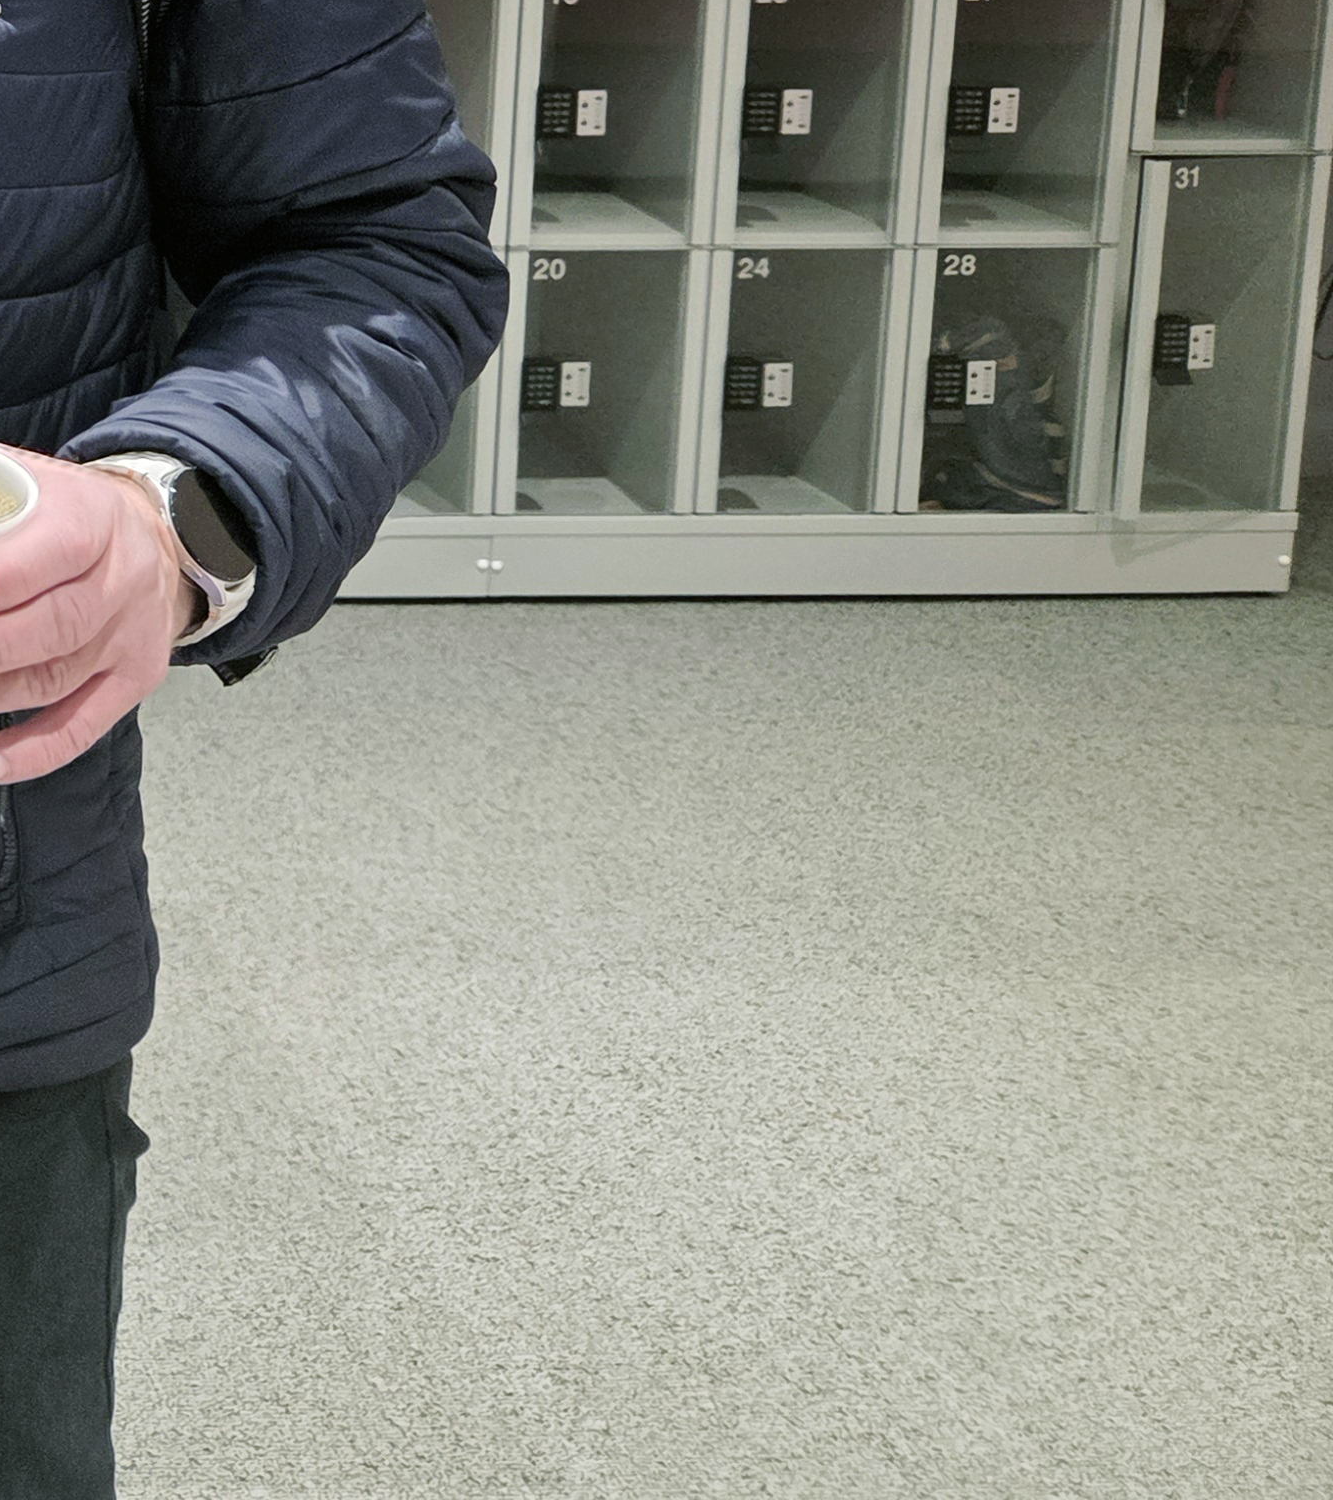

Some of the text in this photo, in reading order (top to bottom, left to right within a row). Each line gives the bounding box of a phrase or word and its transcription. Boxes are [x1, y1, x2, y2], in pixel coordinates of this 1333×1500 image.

[1174, 167, 1201, 188] 31
[532, 257, 566, 281] 20
[737, 257, 770, 280] 24
[943, 254, 977, 277] 28
